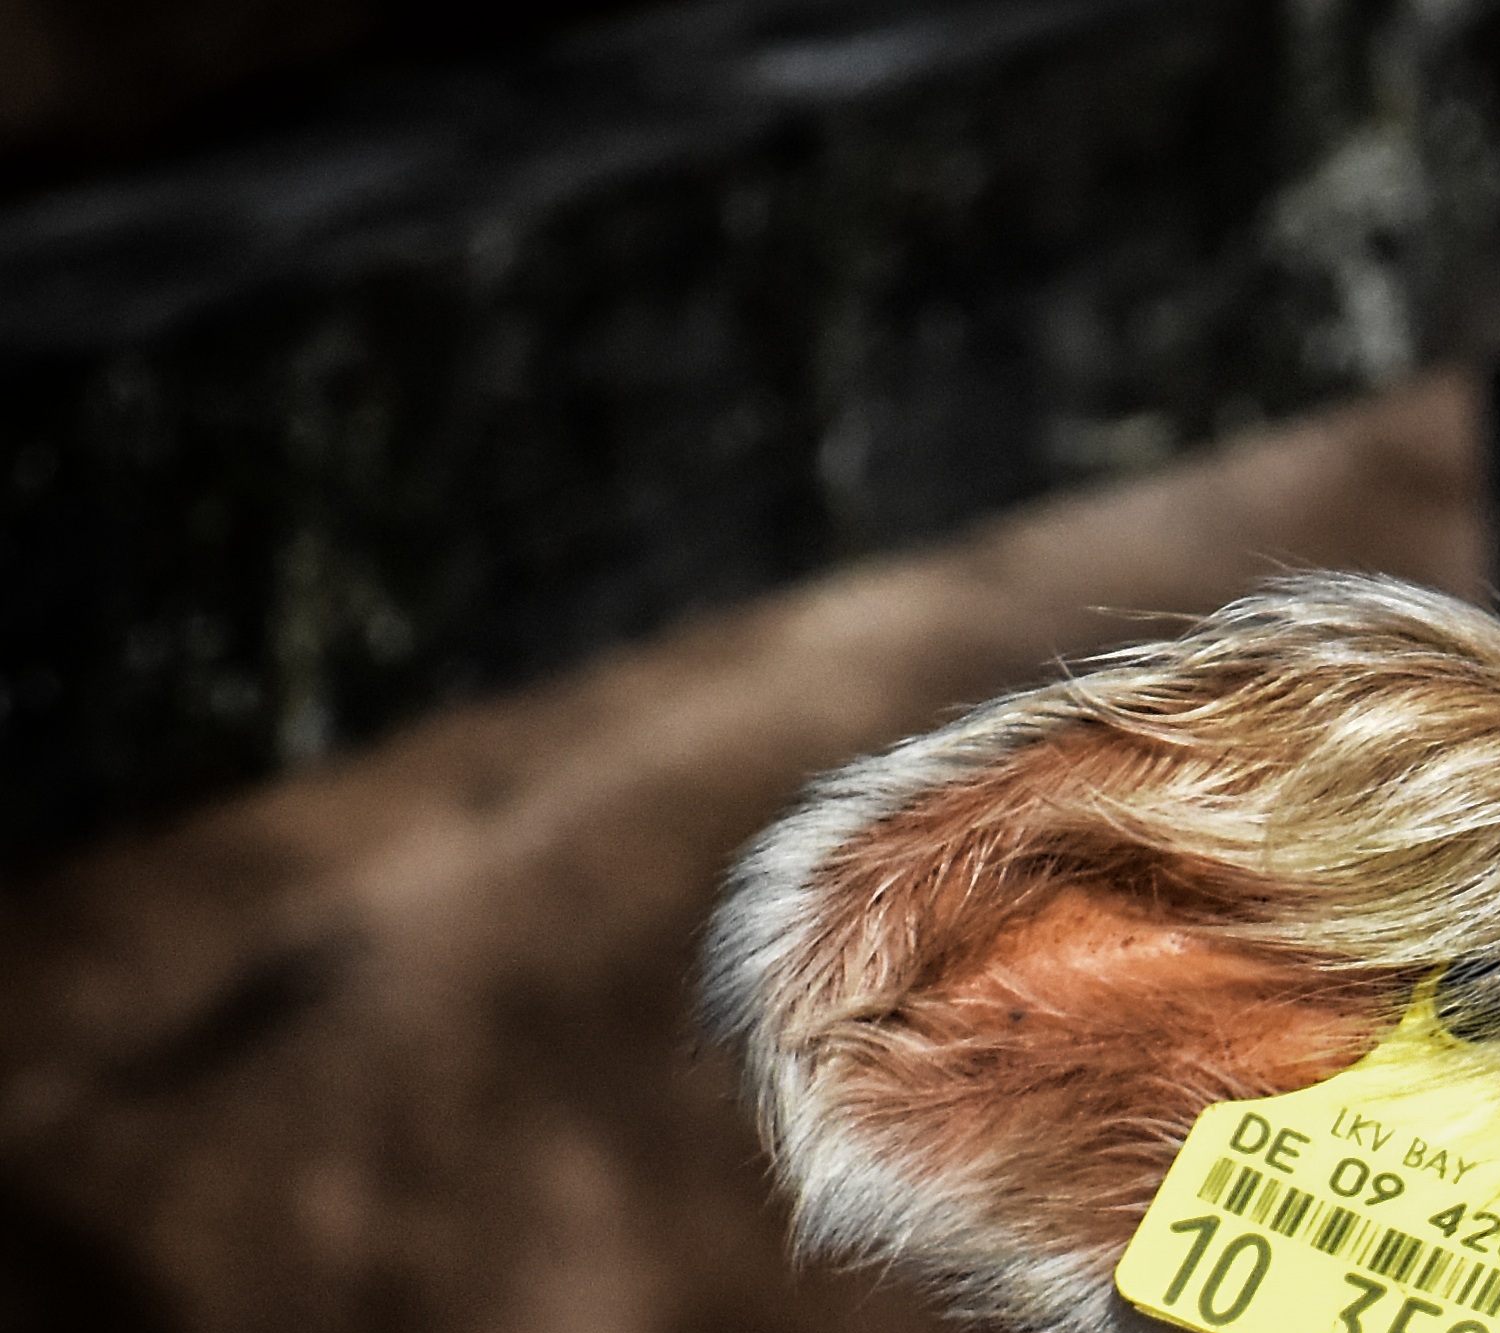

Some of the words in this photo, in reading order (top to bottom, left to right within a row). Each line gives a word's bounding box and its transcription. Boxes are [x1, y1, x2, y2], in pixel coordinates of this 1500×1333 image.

[1229, 1111, 1310, 1174] DE
[1329, 1157, 1406, 1206] 09
[1330, 1107, 1396, 1153] LKV
[1403, 1137, 1479, 1186] BAY
[1161, 1213, 1273, 1327] 10
